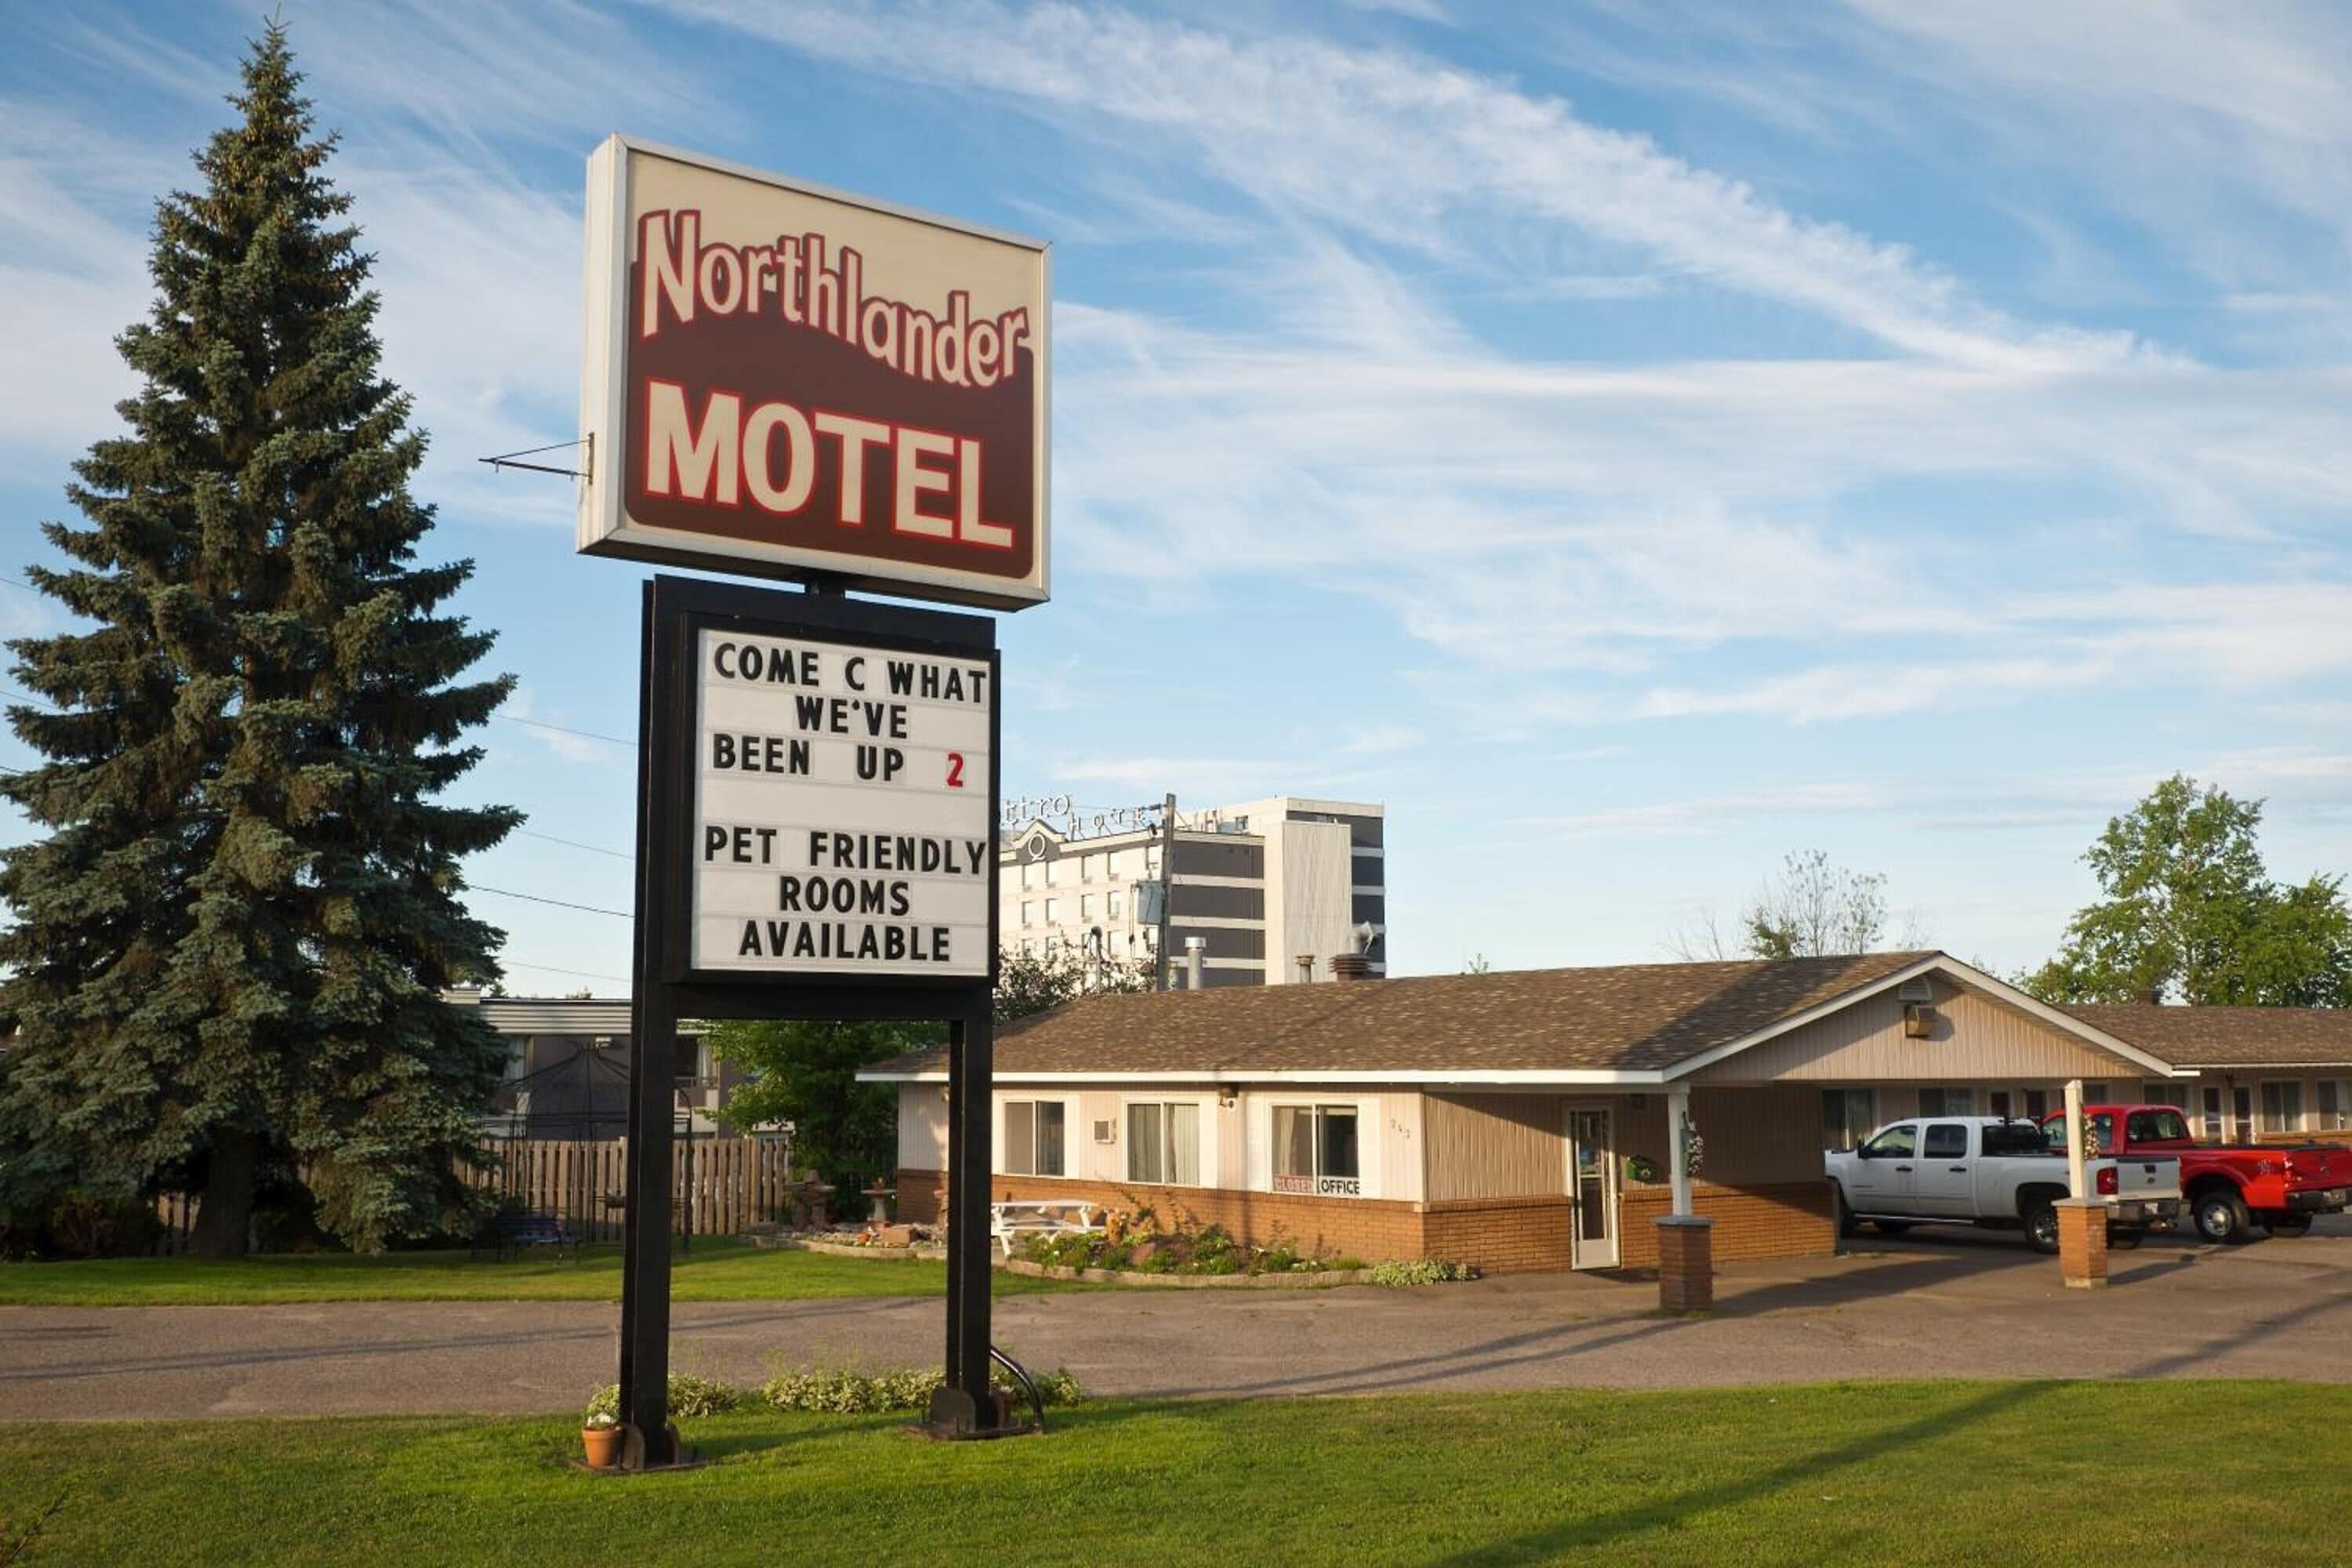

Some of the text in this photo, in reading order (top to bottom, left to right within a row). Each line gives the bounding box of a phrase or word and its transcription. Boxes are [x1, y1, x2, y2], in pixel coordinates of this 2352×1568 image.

[638, 209, 1030, 388] Northlander
[644, 377, 1014, 550] MOTEL
[714, 642, 986, 703] COME C WHAT
[796, 695, 908, 739] WE'VE
[713, 733, 964, 787] BEEN UP 2
[705, 826, 986, 874] PET FRIENDLY
[1028, 833, 1046, 862] Q
[780, 876, 909, 916] ROOMS
[739, 920, 950, 962] AVAILABLE
[1274, 1178, 1314, 1192] CLOSED
[1321, 1179, 1360, 1195] OFFICE
